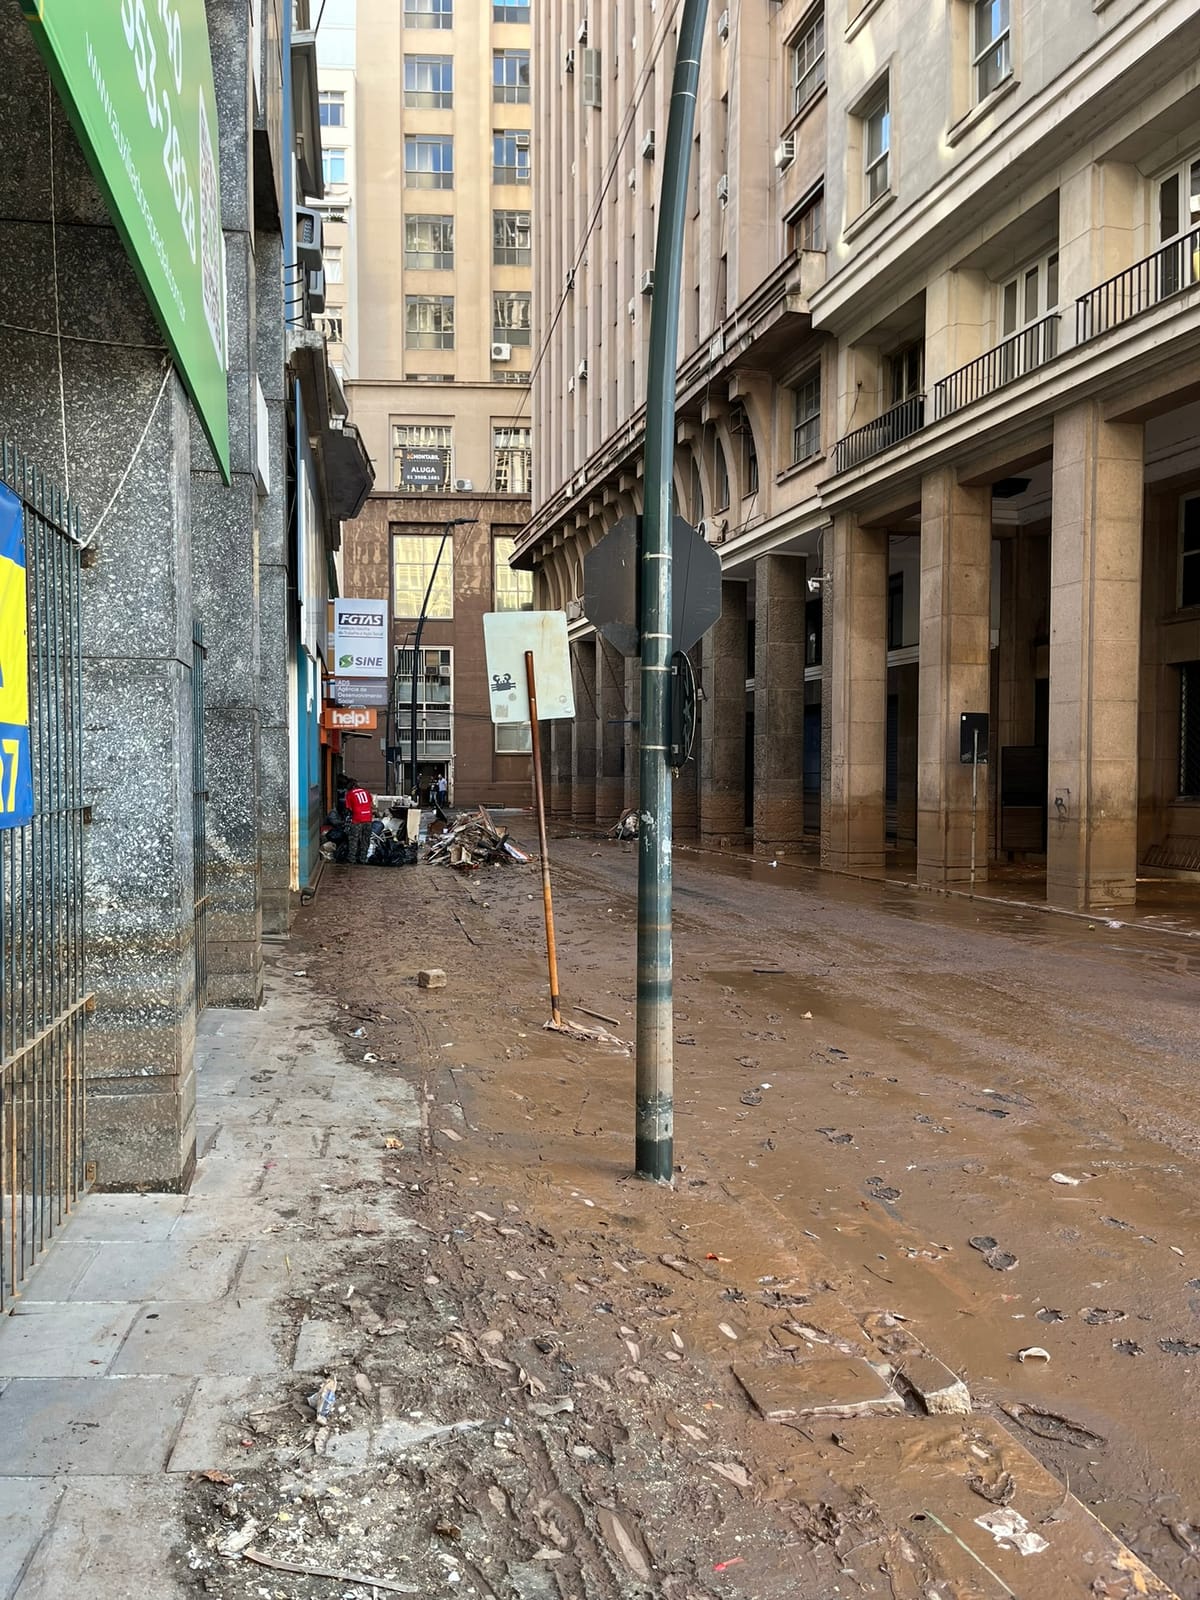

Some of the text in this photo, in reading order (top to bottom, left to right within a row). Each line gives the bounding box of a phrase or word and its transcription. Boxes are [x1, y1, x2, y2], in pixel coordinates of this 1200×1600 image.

[158, 0, 182, 95] 40
[340, 614, 382, 625] FGTAS
[332, 710, 370, 726] help!
[0, 738, 20, 813] 7
[355, 791, 368, 804] 10
